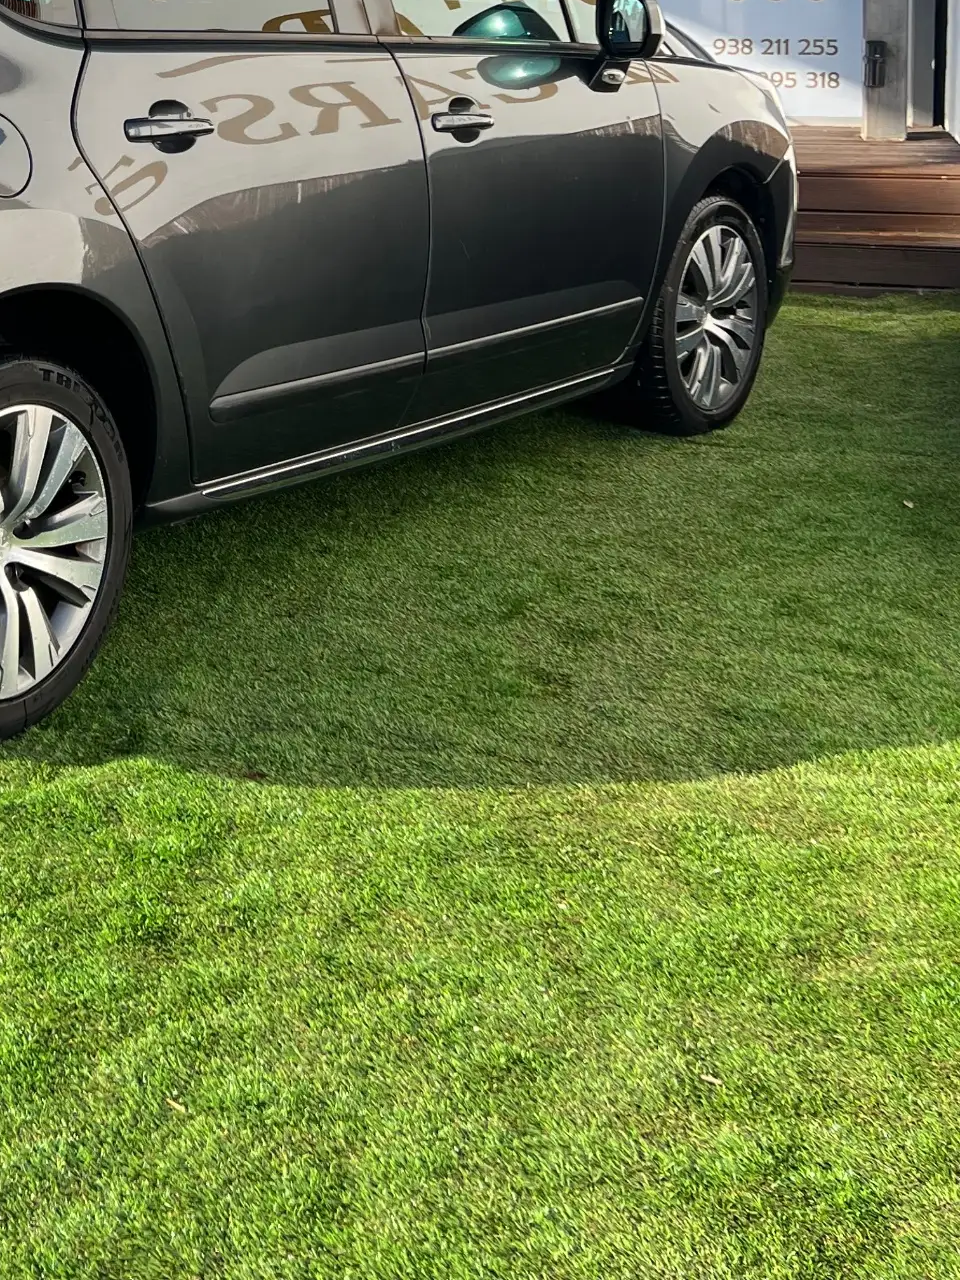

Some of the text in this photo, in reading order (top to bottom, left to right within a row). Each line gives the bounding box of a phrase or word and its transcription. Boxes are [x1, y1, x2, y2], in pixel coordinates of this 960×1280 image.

[713, 38, 839, 56] 938 211 255
[759, 71, 840, 89] 95 318
